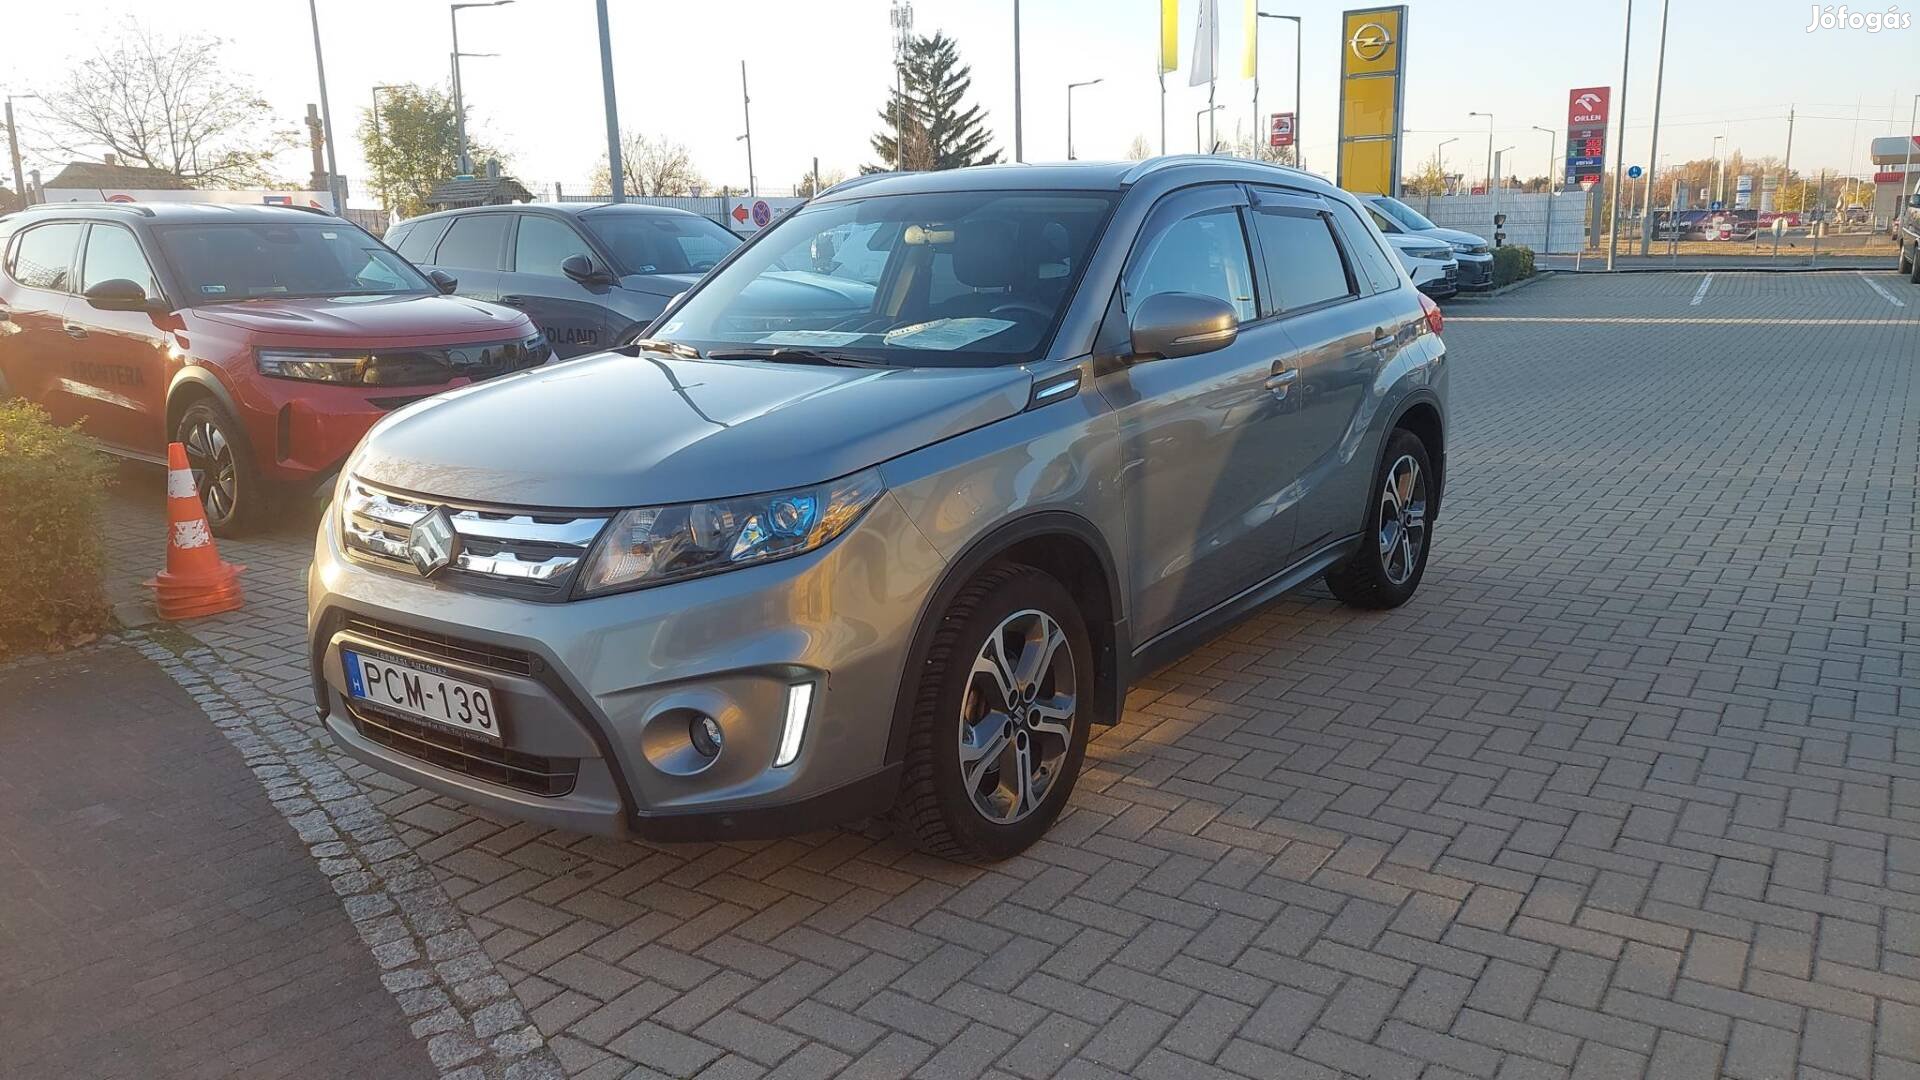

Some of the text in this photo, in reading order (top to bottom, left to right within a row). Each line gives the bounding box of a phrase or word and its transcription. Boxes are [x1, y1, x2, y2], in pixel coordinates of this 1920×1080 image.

[1574, 114, 1601, 122] ORLEN
[546, 327, 598, 345] DLAND
[71, 360, 144, 386] FRONTERA
[352, 678, 361, 691] H
[363, 661, 492, 729] PCM-139
